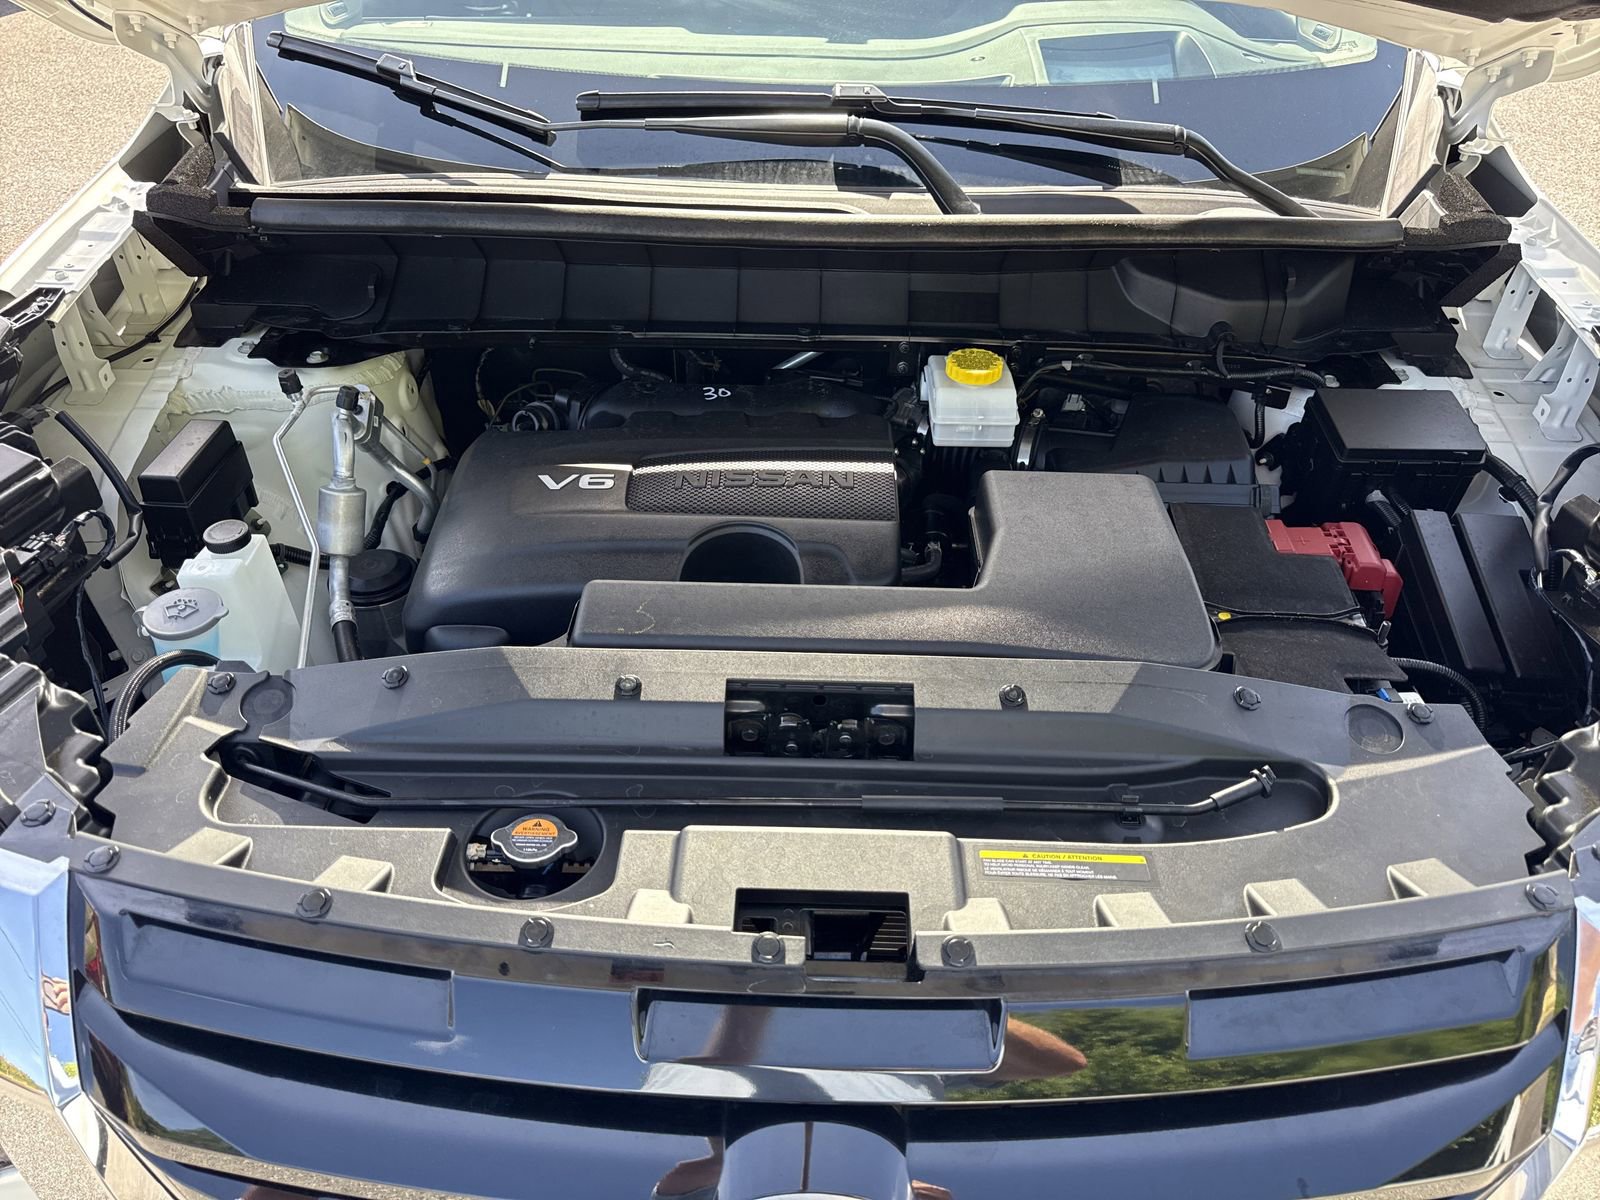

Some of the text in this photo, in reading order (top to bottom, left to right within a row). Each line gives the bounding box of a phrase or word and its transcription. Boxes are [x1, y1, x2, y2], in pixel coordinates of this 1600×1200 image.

[702, 386, 731, 400] 30
[538, 473, 615, 490] V6
[675, 470, 854, 489] NISSAN
